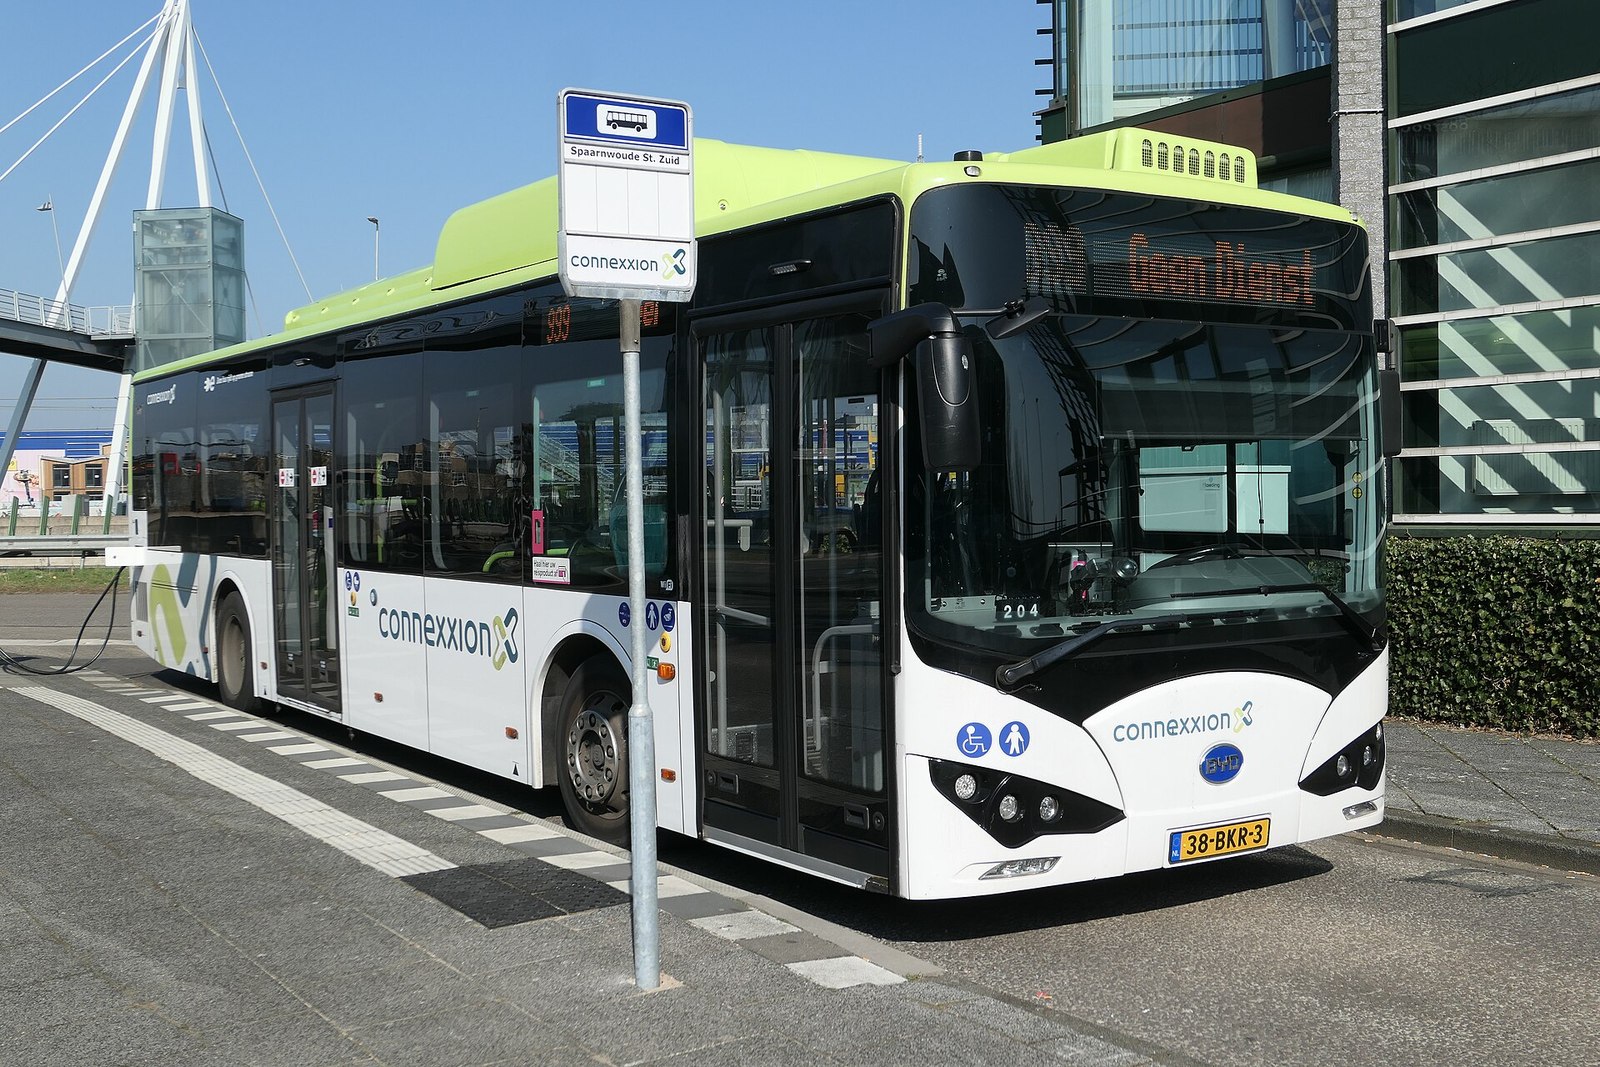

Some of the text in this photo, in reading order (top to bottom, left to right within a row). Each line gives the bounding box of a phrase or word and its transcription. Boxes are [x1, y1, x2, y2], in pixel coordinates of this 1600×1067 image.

[570, 146, 680, 166] Spaarnwoude St. Zuid
[570, 254, 659, 273] connexxion
[1129, 233, 1206, 296] Geen
[1215, 241, 1314, 305] Dienst
[546, 304, 571, 343] 999
[1003, 603, 1039, 619] 204
[379, 607, 492, 658] connexxion
[1113, 712, 1230, 743] connexxion
[1205, 754, 1240, 774] BYD
[1186, 824, 1263, 855] 38-BKR-3
